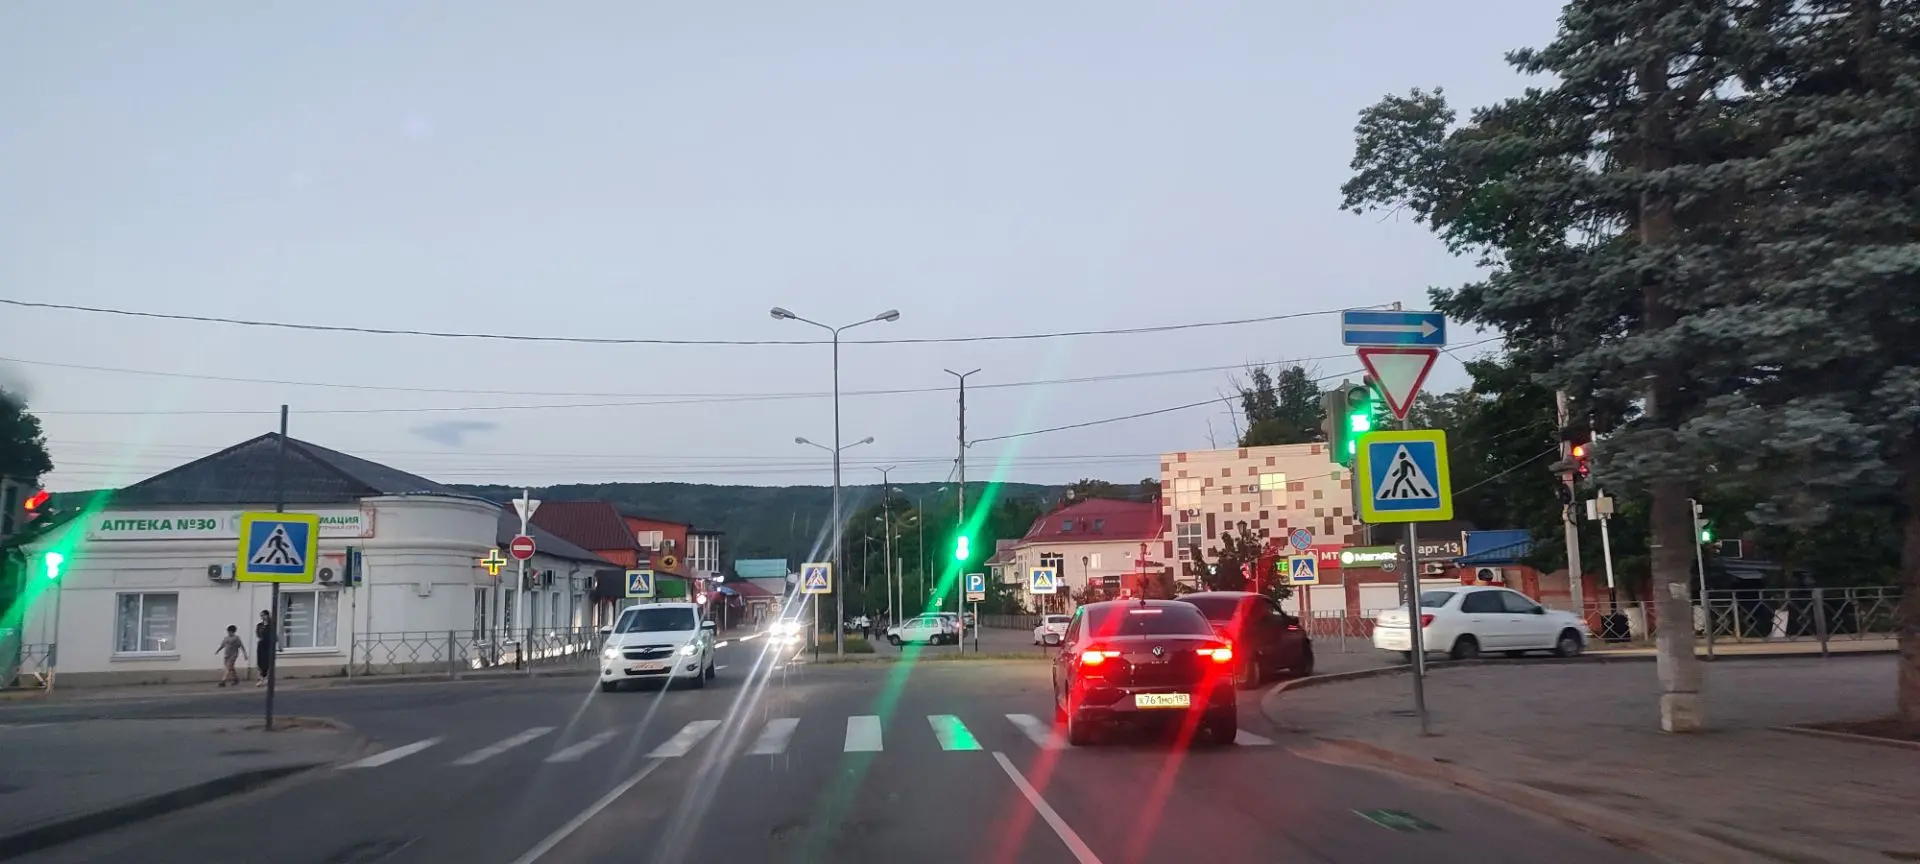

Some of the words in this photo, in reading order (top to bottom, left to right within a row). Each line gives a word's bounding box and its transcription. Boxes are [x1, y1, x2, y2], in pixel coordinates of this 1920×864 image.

[100, 518, 173, 531] АПТЕКА
[177, 518, 217, 531] №30
[319, 515, 359, 525] МАЦИЯ
[1399, 542, 1459, 556] Сарт-13
[1321, 551, 1339, 561] МТ
[1275, 561, 1288, 572] TE
[971, 575, 982, 591] P
